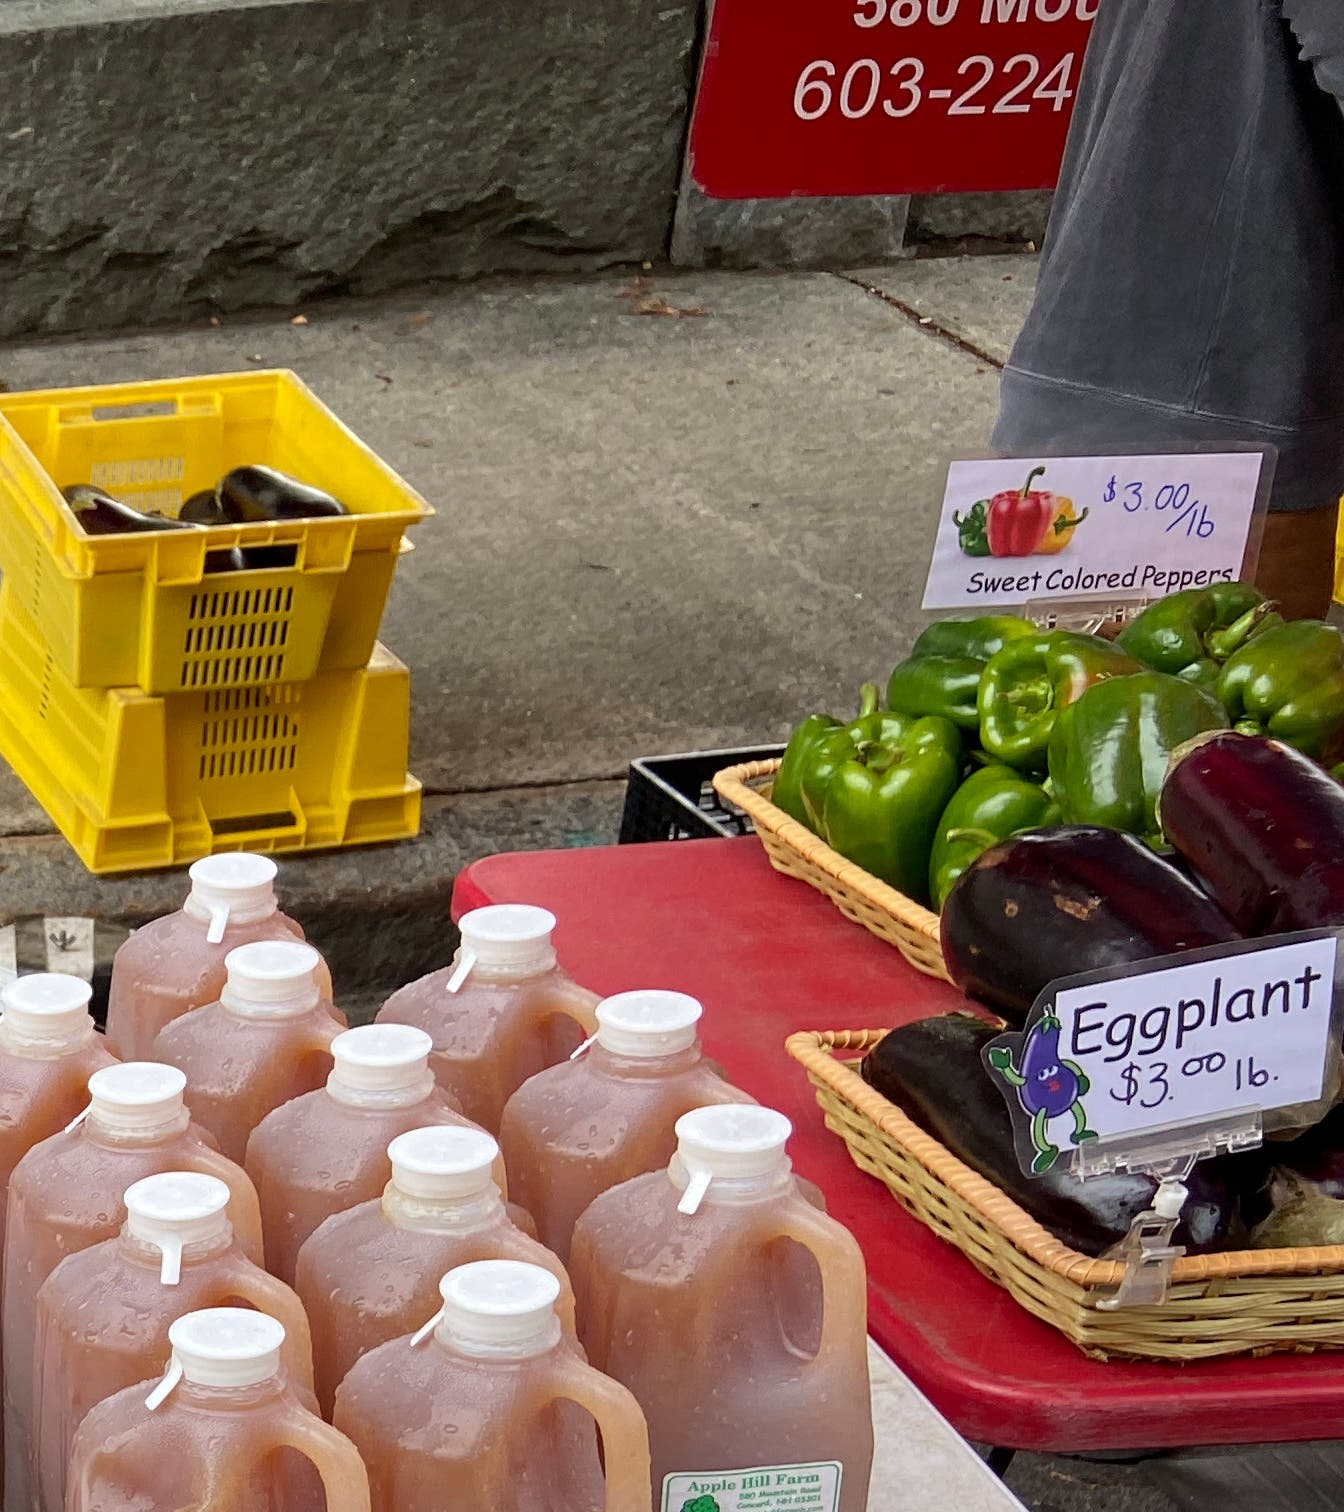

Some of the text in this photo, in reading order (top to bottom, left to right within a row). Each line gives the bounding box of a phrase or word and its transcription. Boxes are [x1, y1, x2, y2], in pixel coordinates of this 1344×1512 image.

[793, 52, 1075, 120] 603-224
[966, 565, 1233, 594] Sweet Colored Peppers
[1070, 966, 1322, 1063] Eggplant
[1235, 1056, 1279, 1091] lb.
[688, 1474, 820, 1493] Apple Hill Farm
